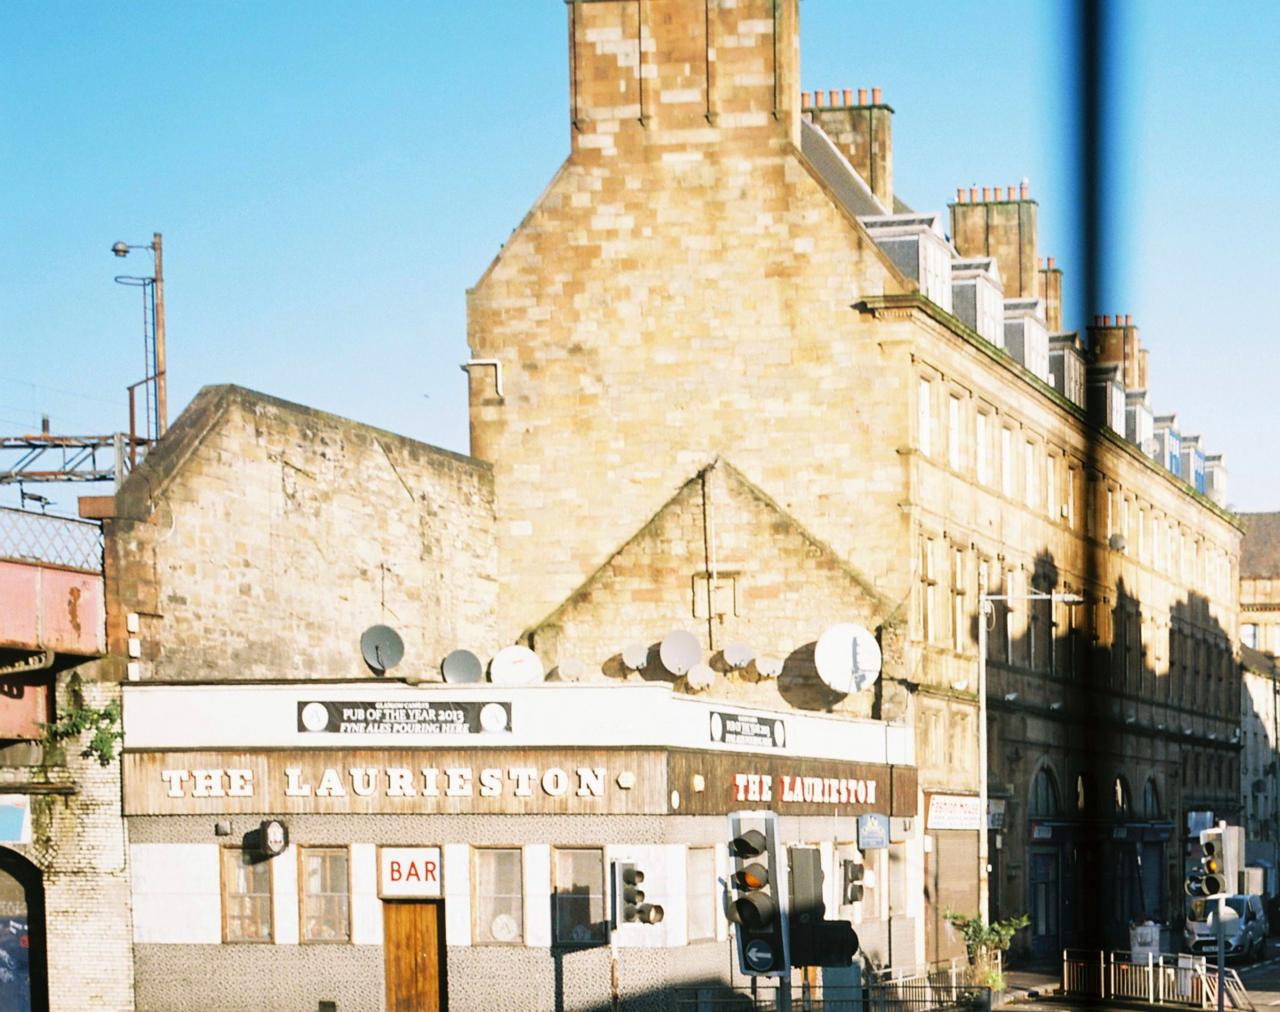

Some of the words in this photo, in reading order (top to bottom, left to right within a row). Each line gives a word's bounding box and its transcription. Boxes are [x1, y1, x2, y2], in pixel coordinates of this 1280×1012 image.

[343, 709, 365, 720] PUB
[366, 709, 382, 720] OF
[383, 709, 407, 721] THE
[407, 709, 436, 720] YEAR
[438, 710, 465, 723] 2013
[393, 723, 440, 733] POURING
[161, 768, 254, 798] THE
[284, 768, 607, 798] LAURIESTON
[733, 773, 772, 802] THE
[781, 775, 877, 804] LAURIESTON
[390, 861, 438, 882] BAR
